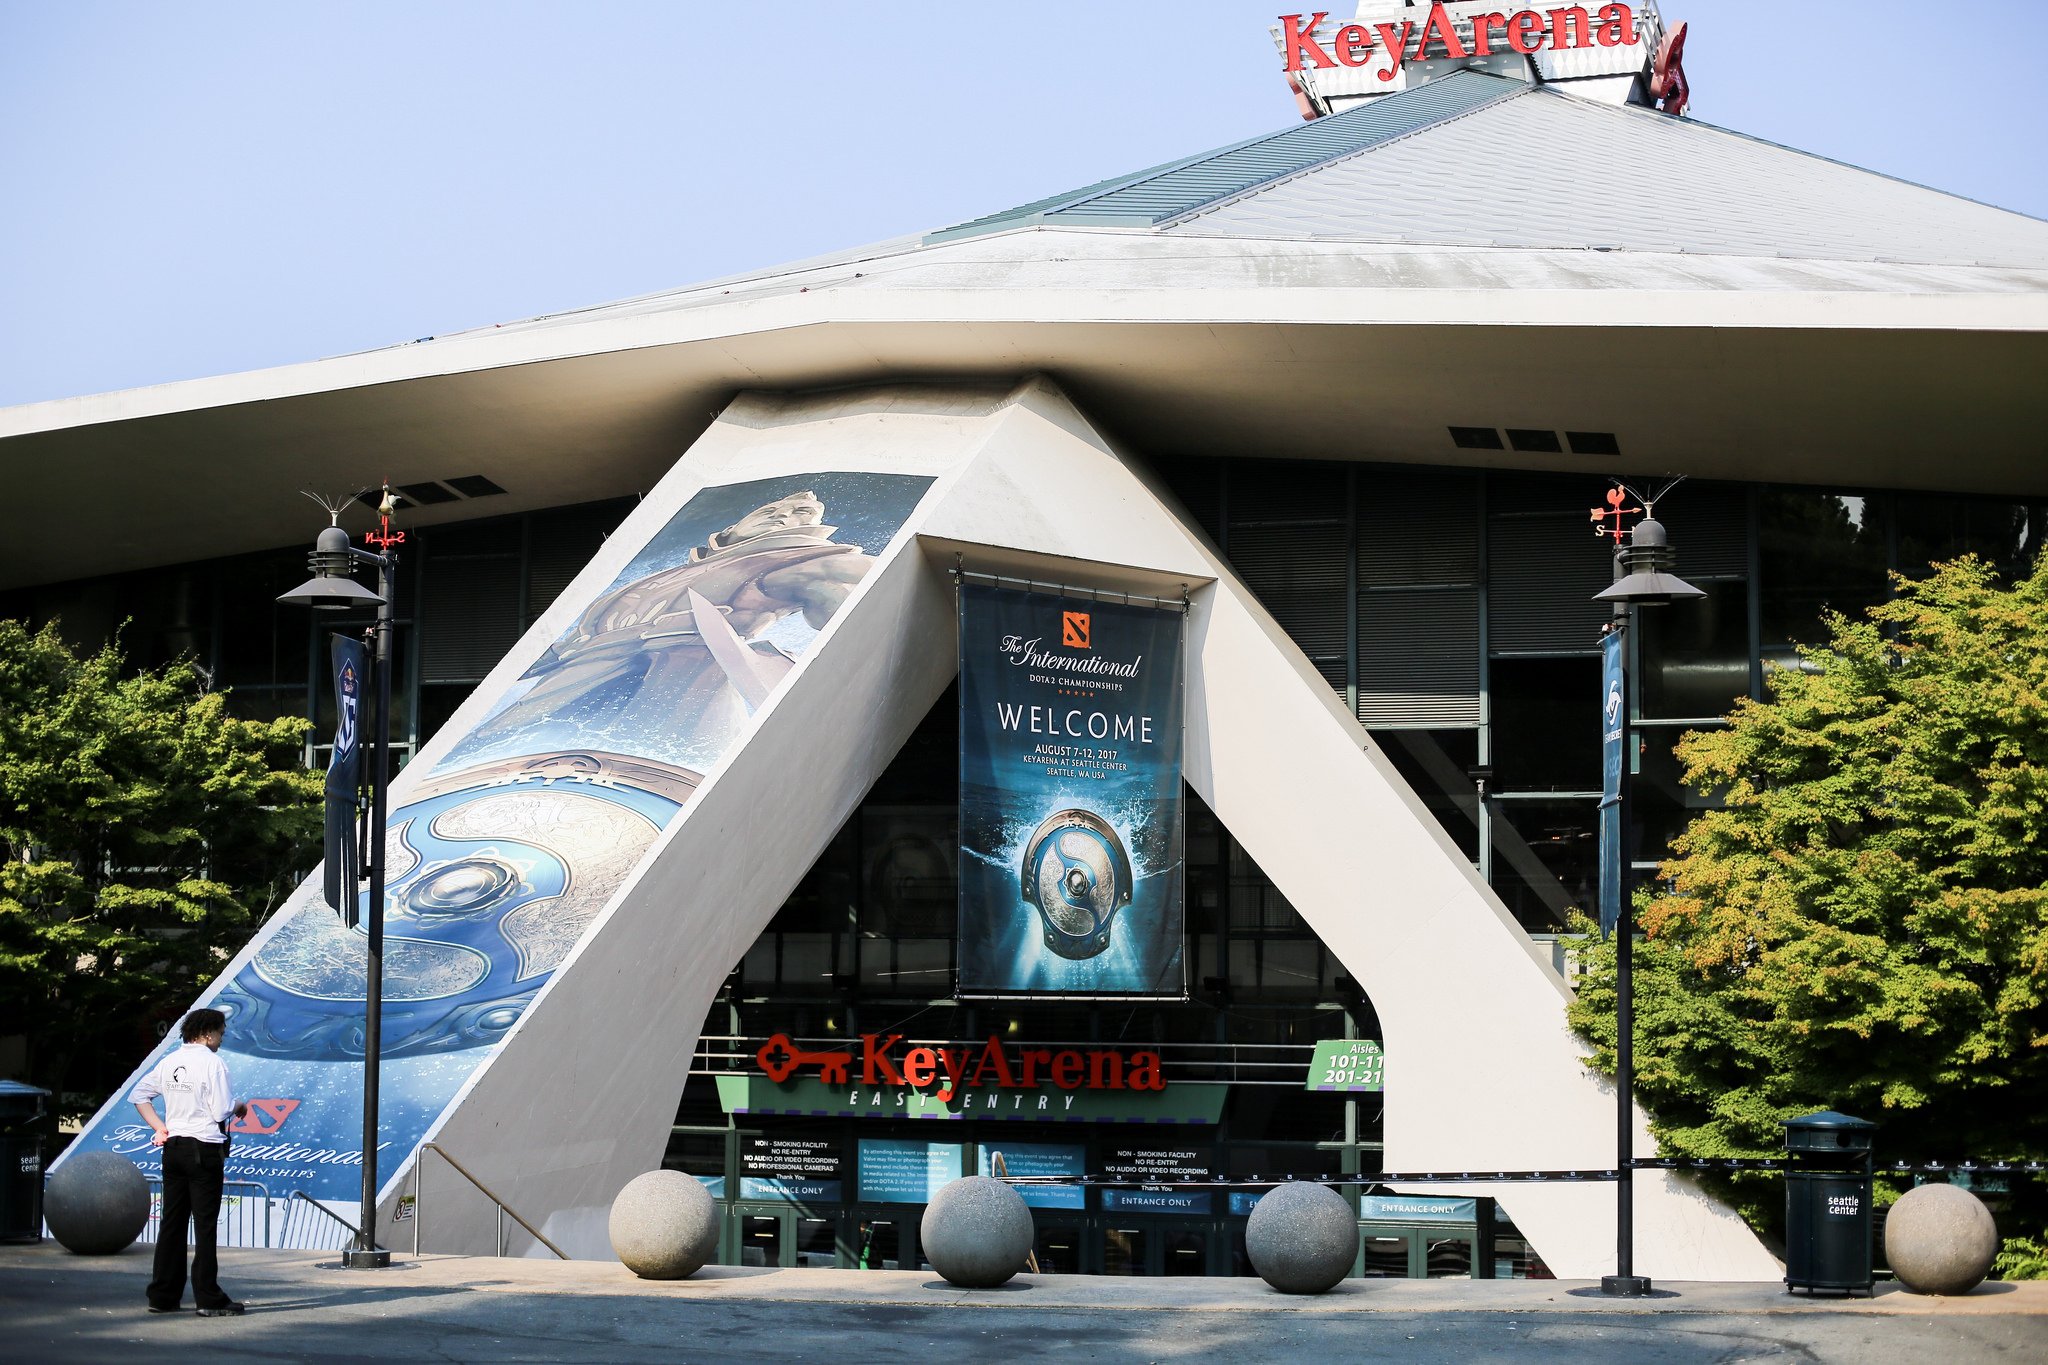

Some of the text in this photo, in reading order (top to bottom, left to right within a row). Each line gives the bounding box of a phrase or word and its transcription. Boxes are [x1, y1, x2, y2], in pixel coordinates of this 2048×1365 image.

[1277, 0, 1643, 82] KeyArena
[999, 635, 1142, 678] The International
[1058, 678, 1123, 692] CHAMPIONSHIPS
[998, 702, 1152, 744] WELCOME
[1035, 744, 1118, 760] AUGUST 7-12, 2017
[1024, 754, 1127, 771] KEYARENA AT SEATTLE CENTER
[1047, 768, 1105, 779] SEATTLE, WA USA
[1350, 1044, 1379, 1054] Aisles
[860, 1034, 1167, 1102] KeyArena
[1324, 1070, 1384, 1084] 201-21
[850, 1091, 1074, 1110] EAST ENTRY
[758, 1186, 799, 1194] ENTRANCE
[1828, 1196, 1858, 1206] seattle
[1382, 1205, 1428, 1213] ENTRANCE
[1829, 1206, 1858, 1215] center
